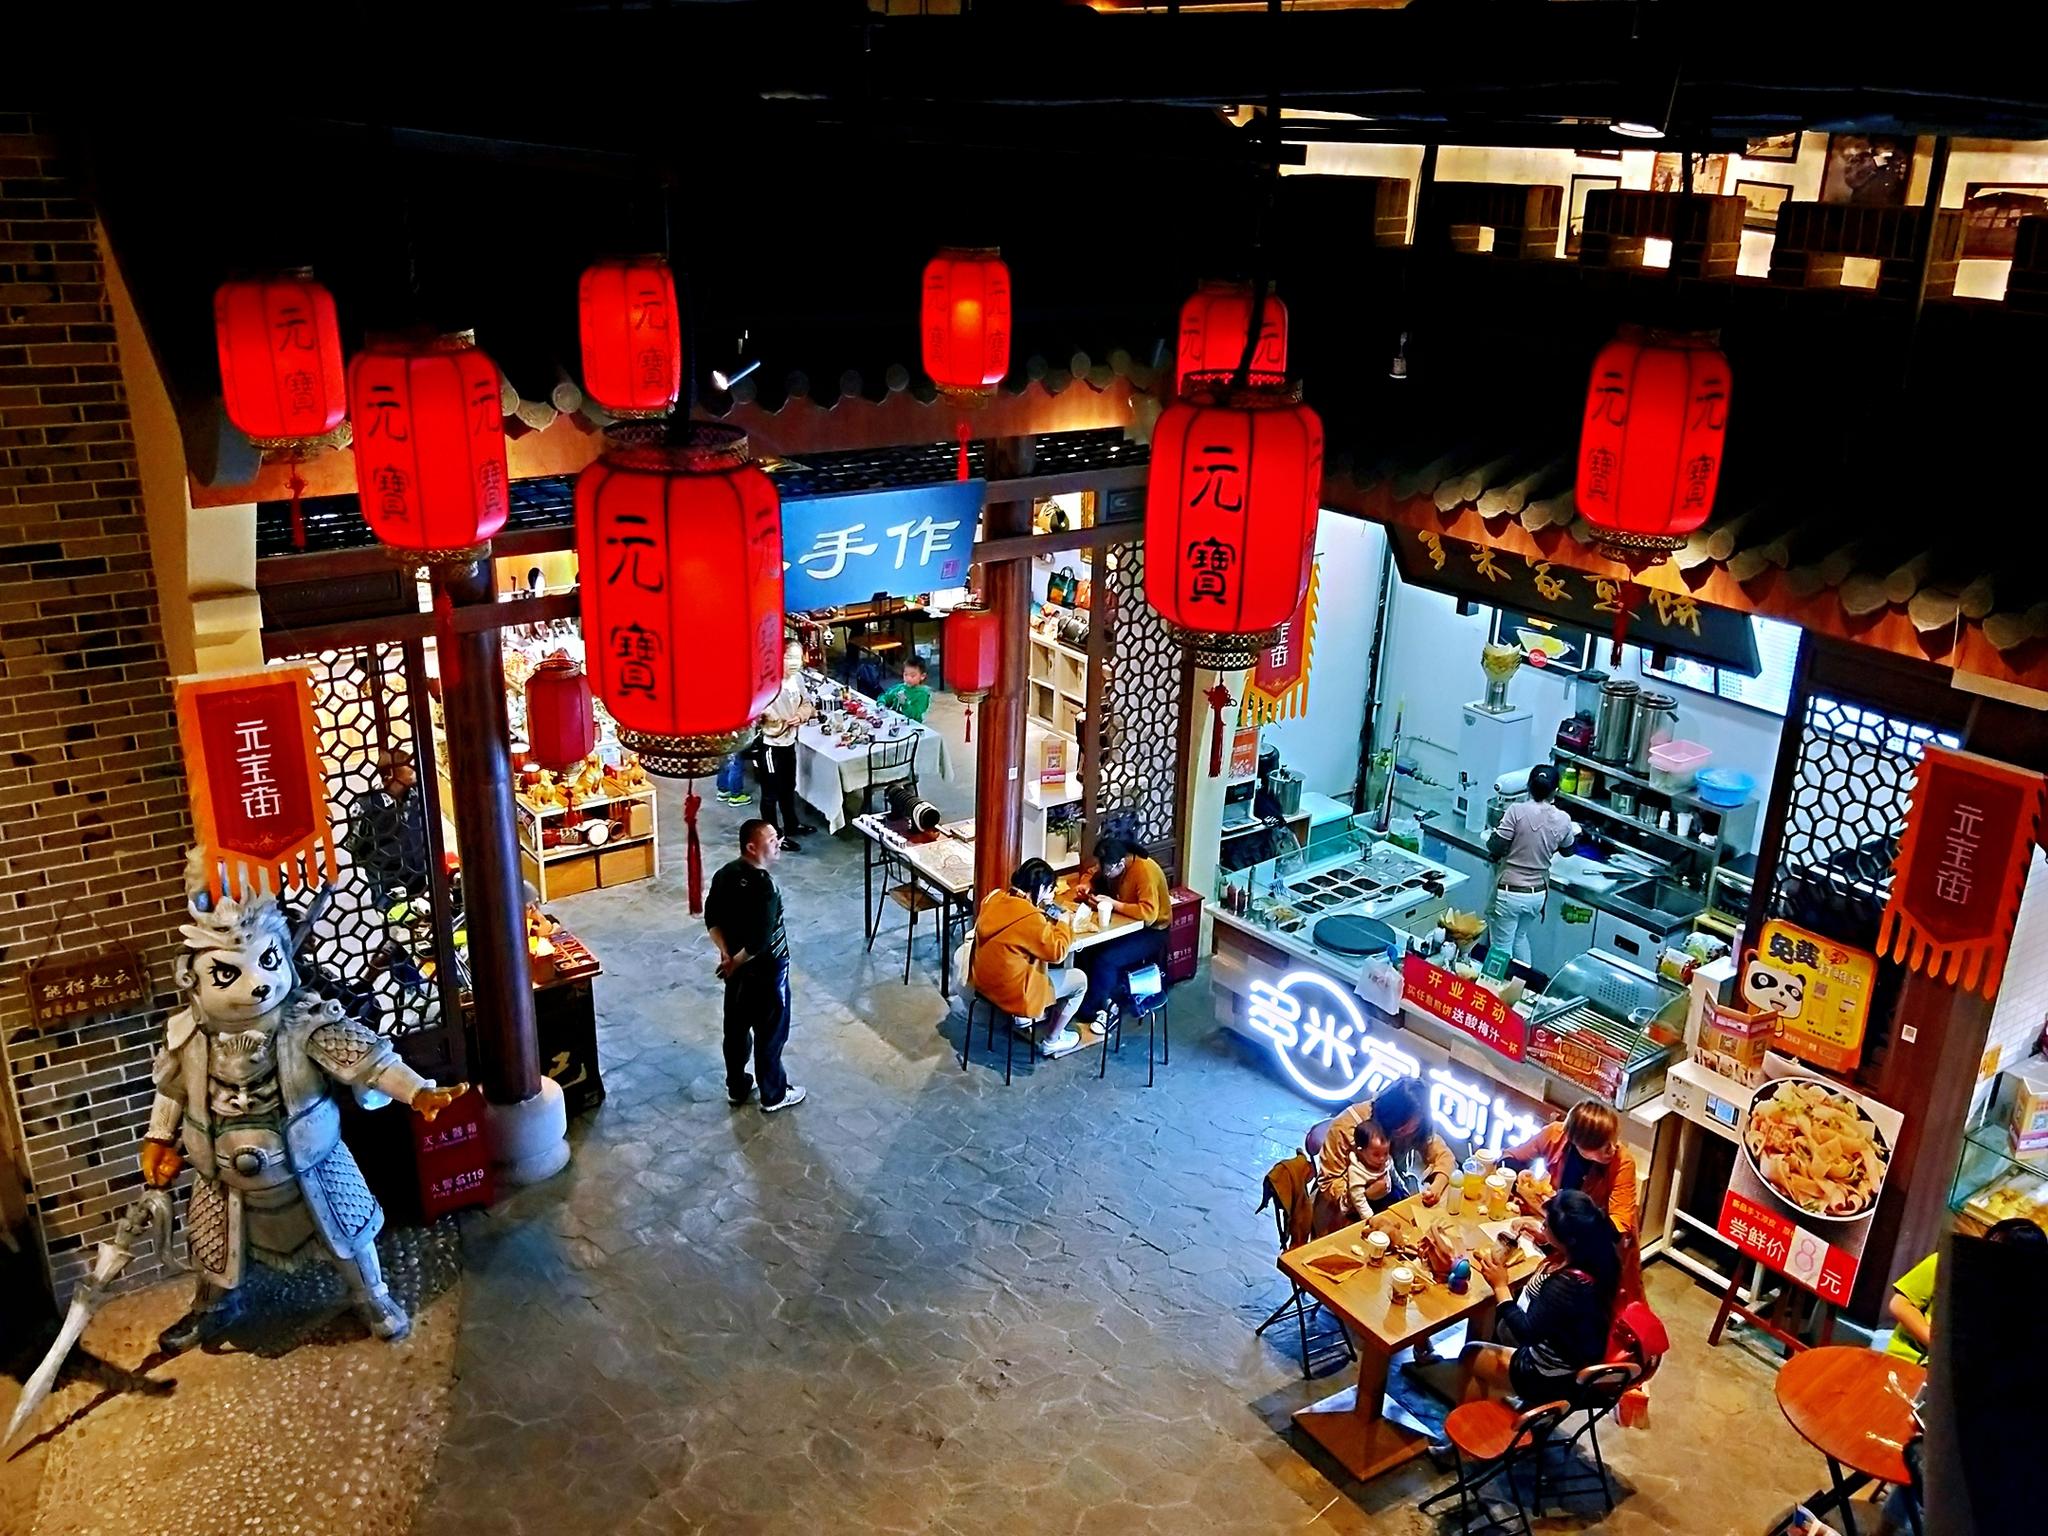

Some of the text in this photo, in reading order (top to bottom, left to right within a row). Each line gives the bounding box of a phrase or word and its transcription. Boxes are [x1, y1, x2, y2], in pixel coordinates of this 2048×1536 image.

[783, 515, 961, 580] 手作
[1428, 969, 1506, 1025] 开业活动
